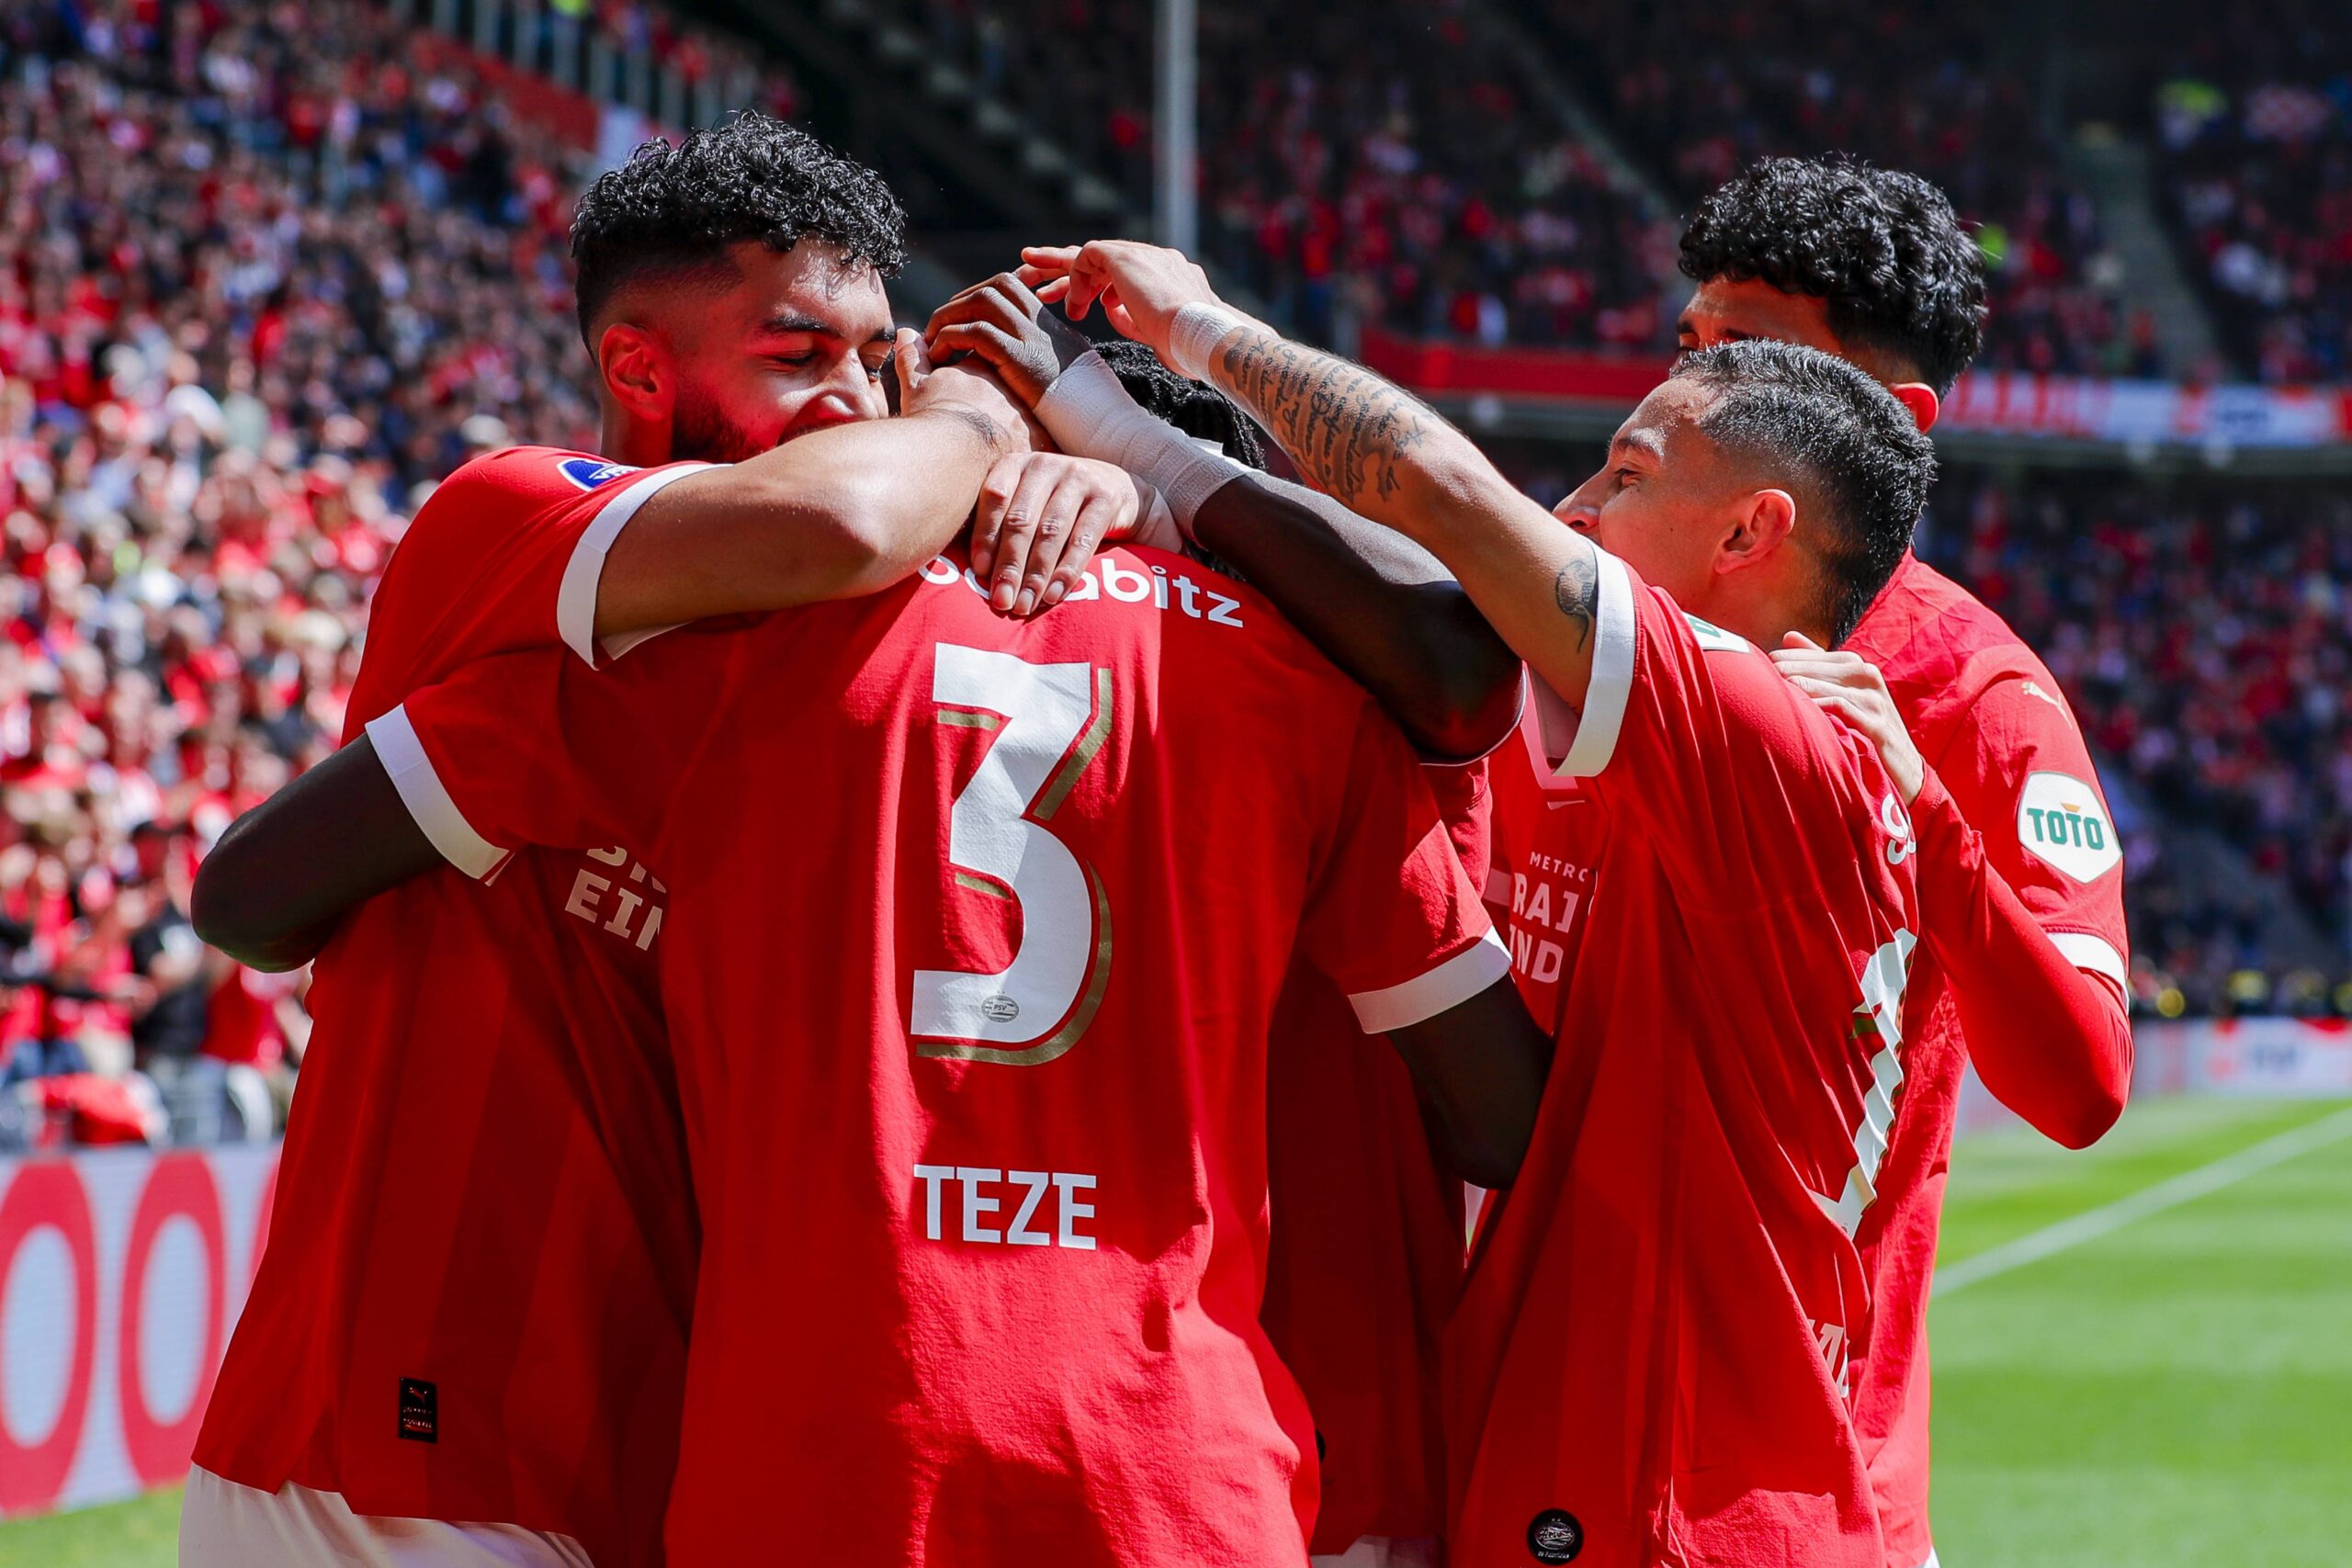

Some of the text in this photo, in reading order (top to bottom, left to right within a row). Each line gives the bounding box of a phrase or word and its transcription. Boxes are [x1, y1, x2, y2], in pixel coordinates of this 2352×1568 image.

[910, 642, 1112, 1066] 3
[2027, 807, 2106, 851] TOTO
[913, 1164, 1097, 1250] TEZE
